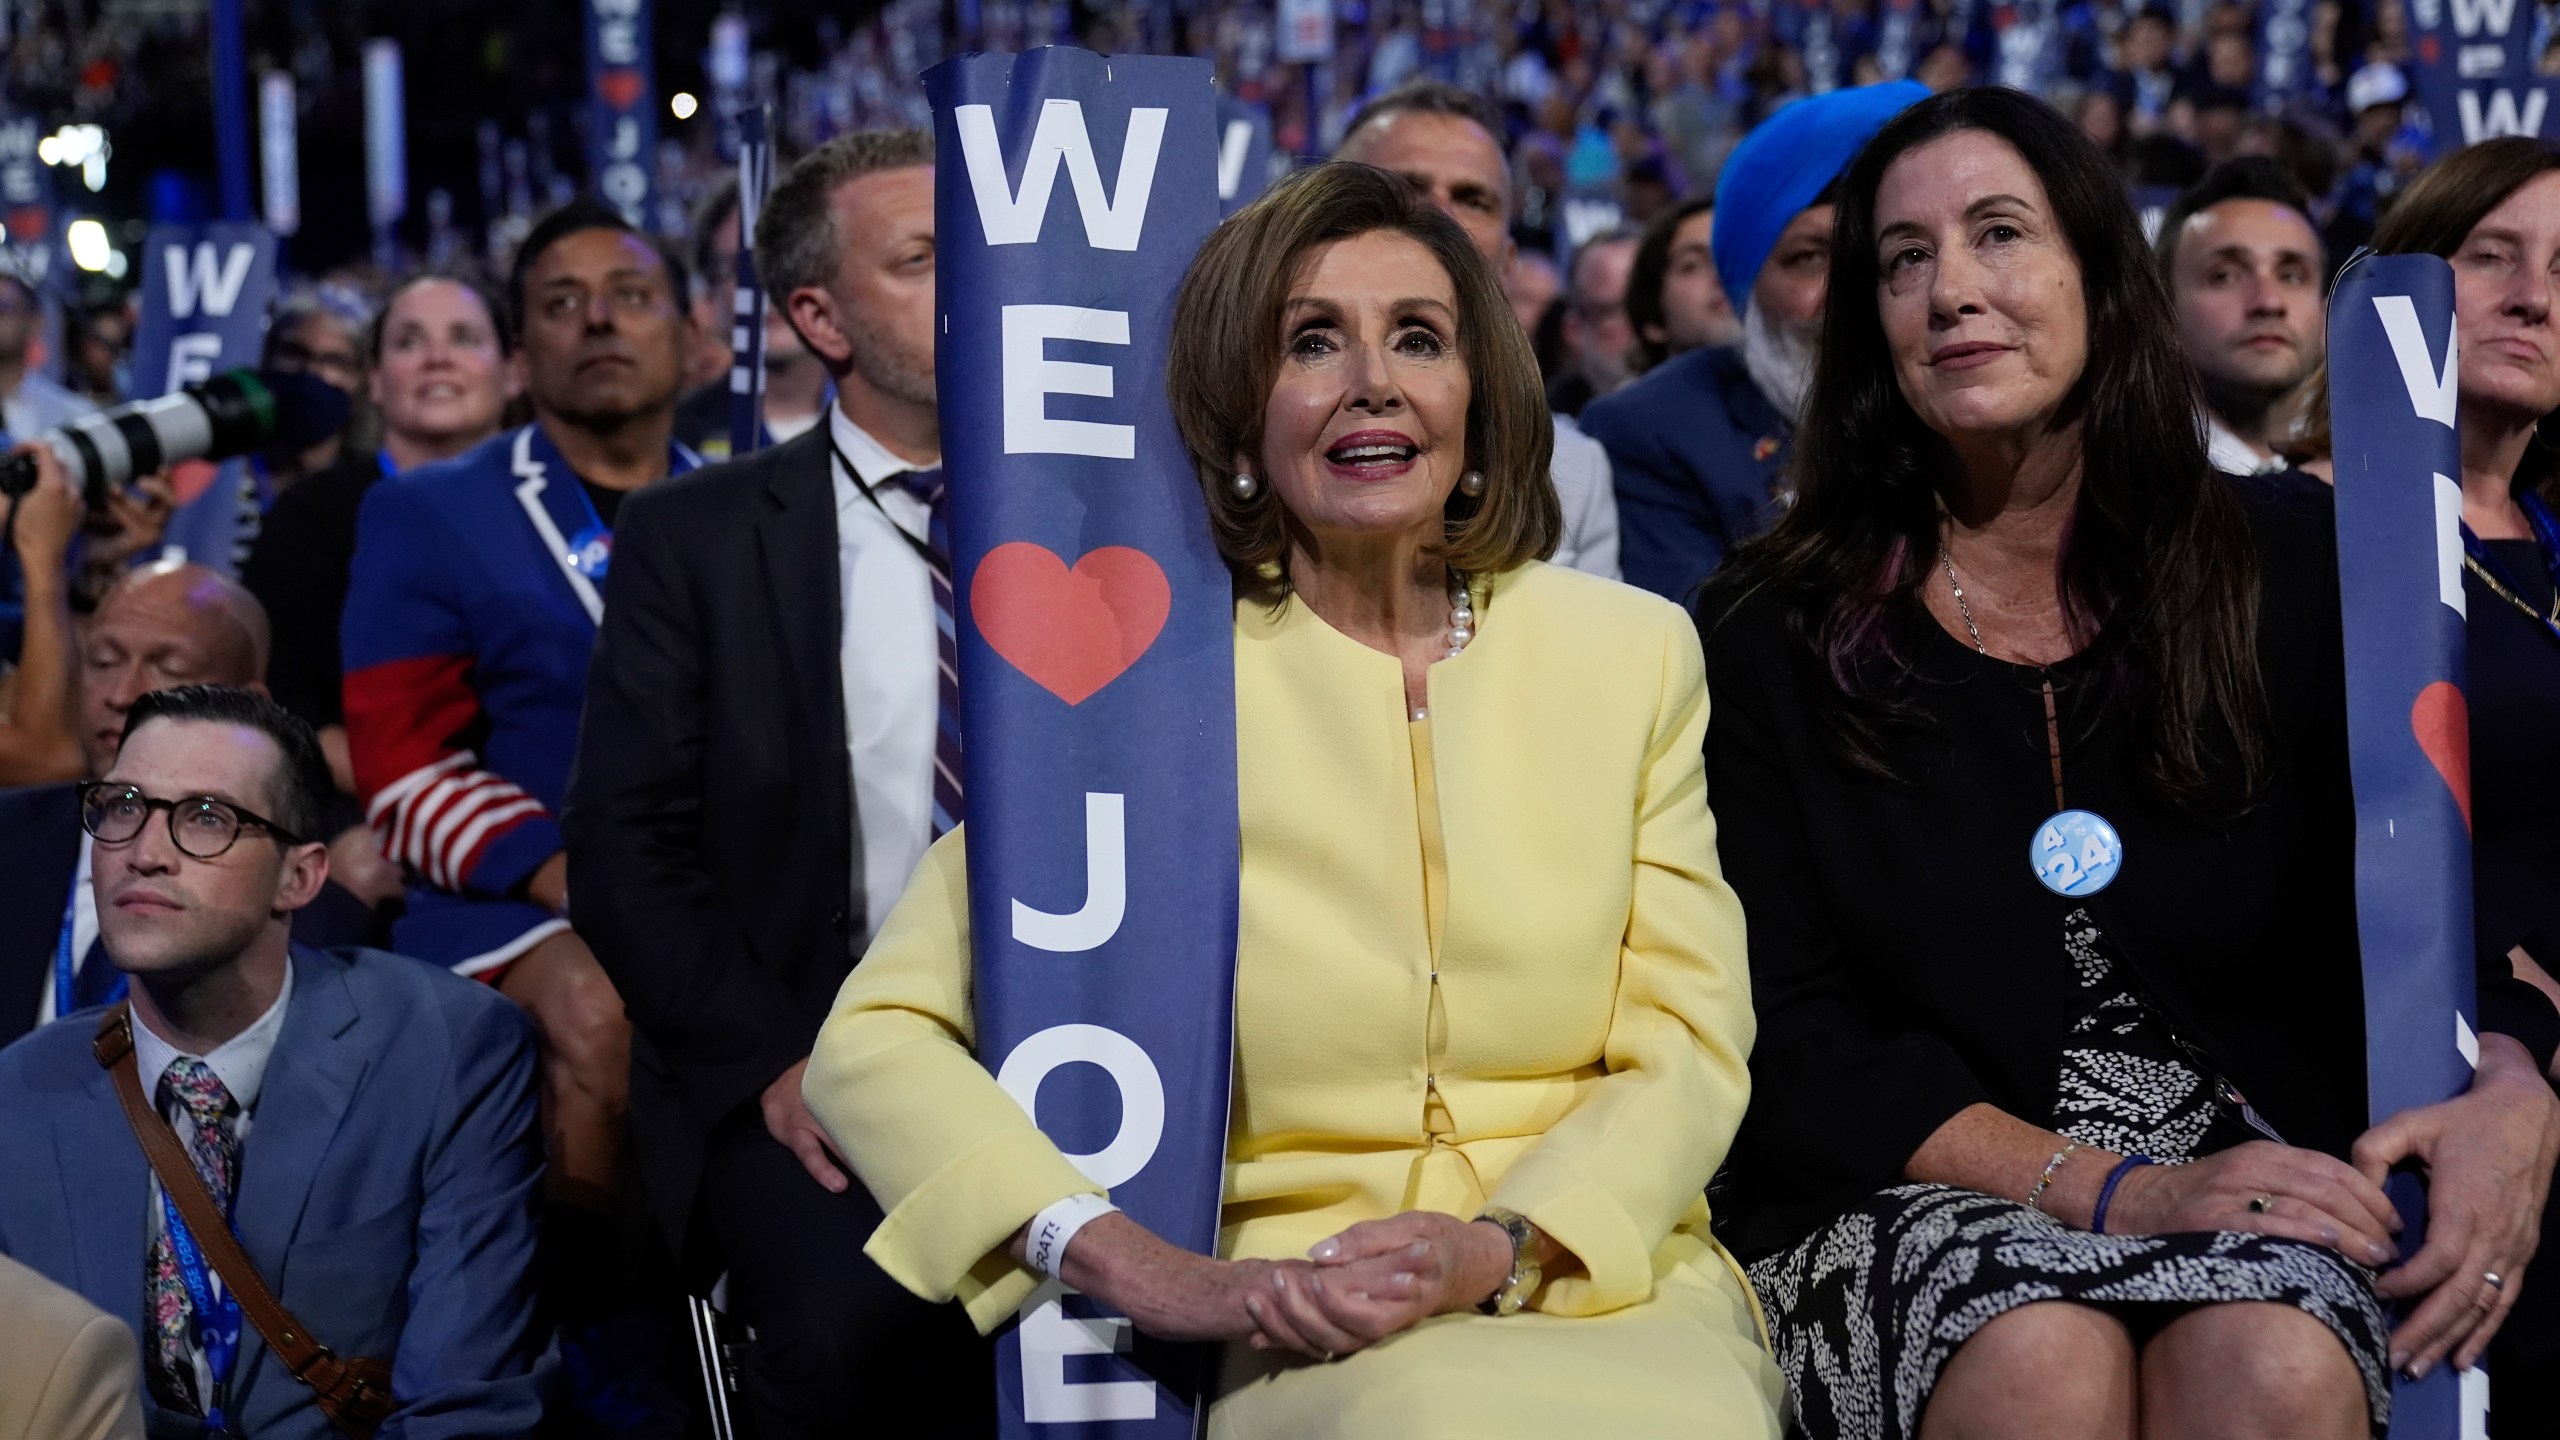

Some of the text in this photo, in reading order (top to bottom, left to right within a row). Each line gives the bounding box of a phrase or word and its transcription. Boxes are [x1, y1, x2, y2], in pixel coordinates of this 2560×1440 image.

[956, 98, 1169, 1424] WE JOE
[185, 1266, 211, 1317] HOUSE
